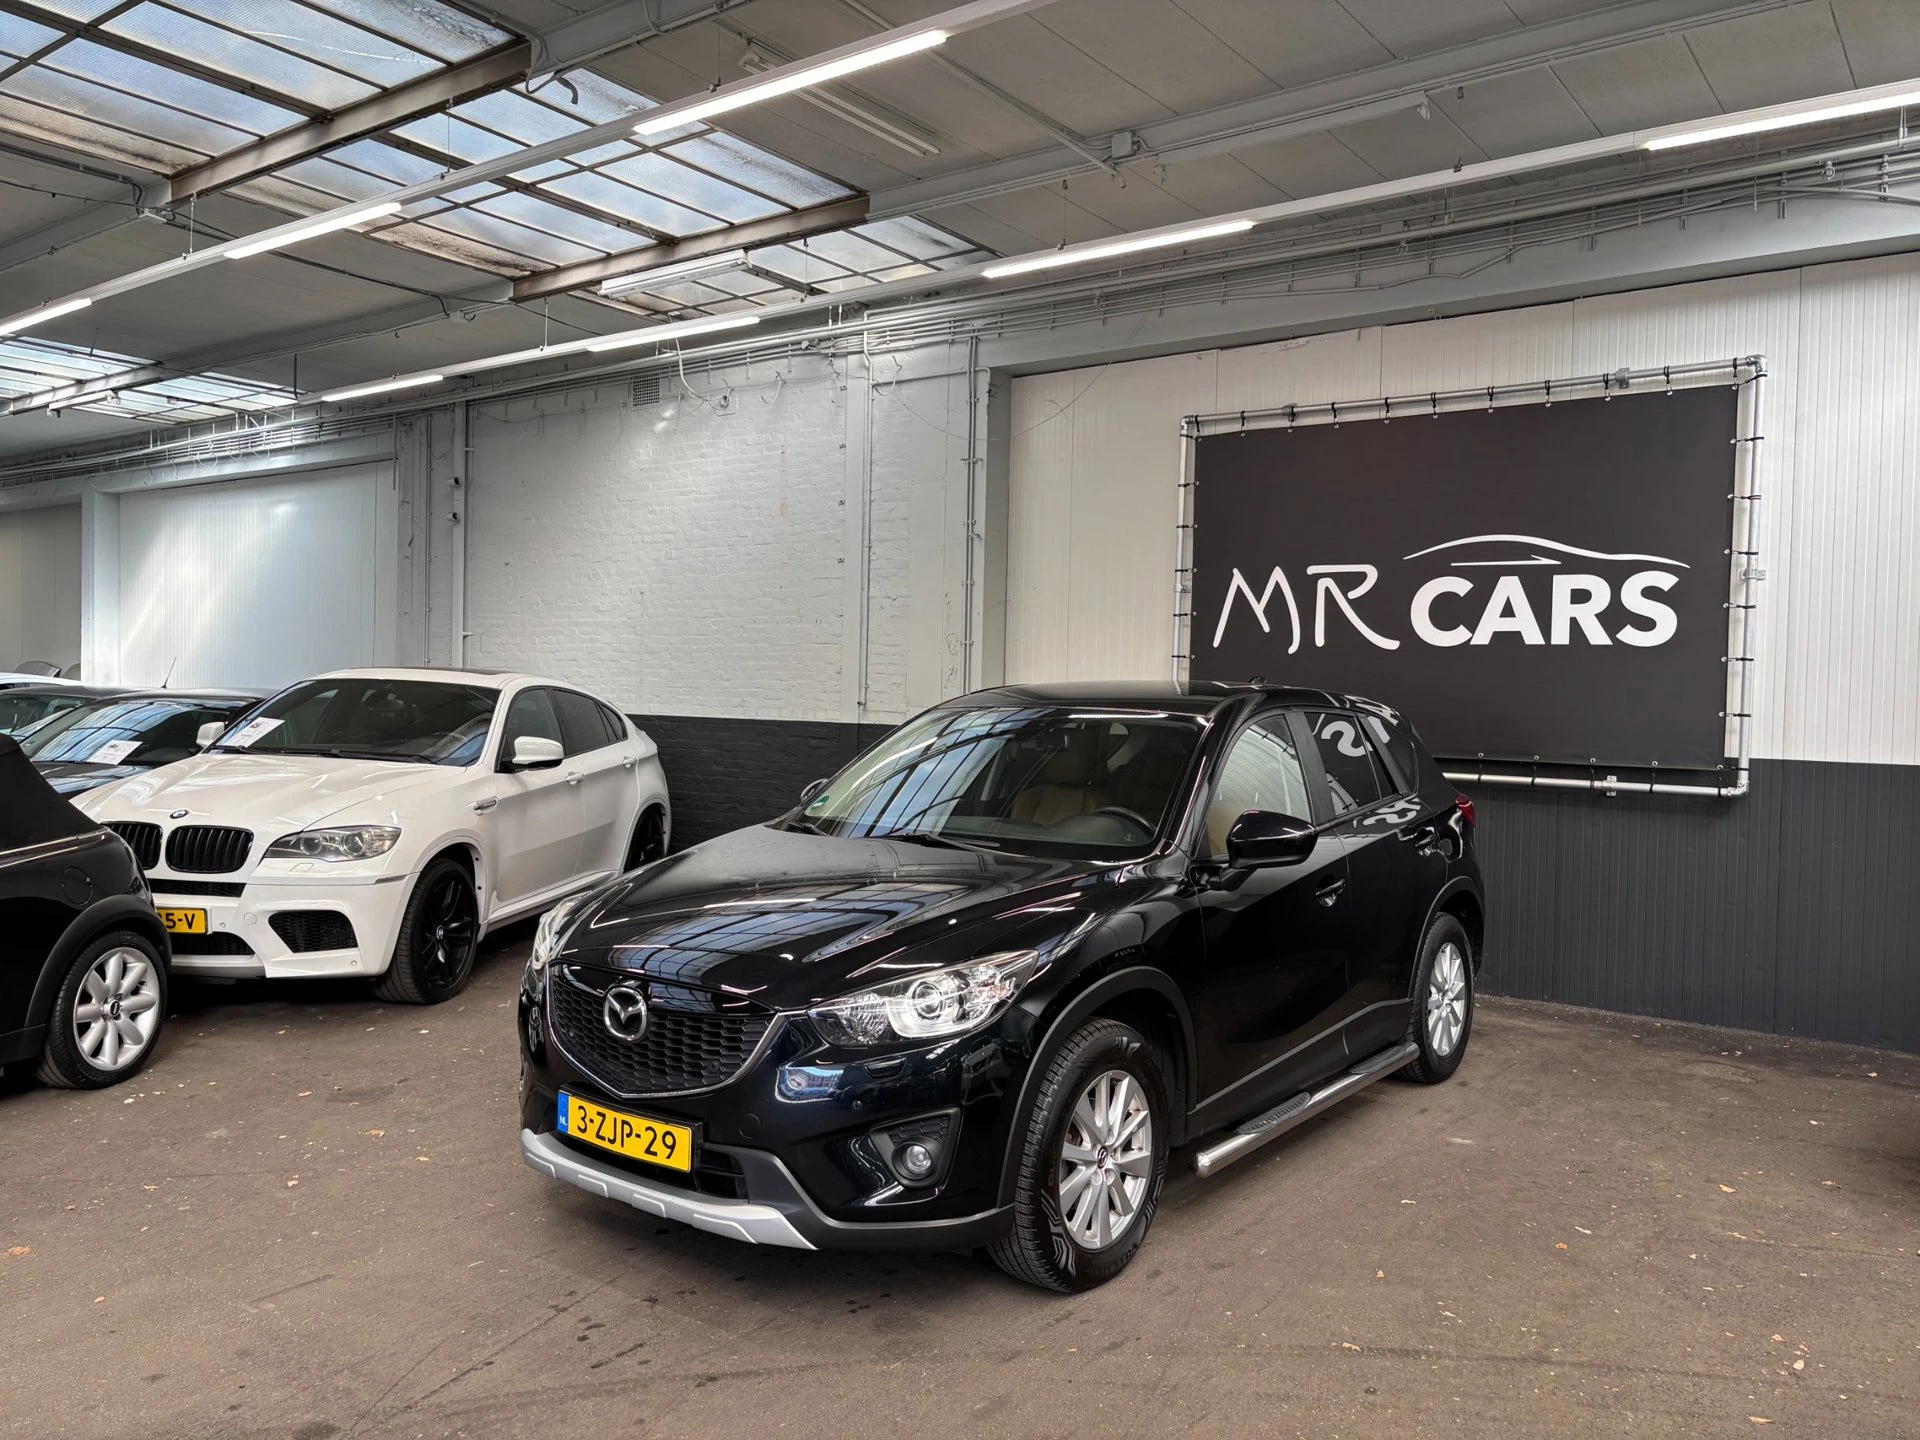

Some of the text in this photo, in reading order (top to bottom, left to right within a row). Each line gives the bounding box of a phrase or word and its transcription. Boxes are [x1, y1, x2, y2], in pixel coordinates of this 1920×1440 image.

[1213, 564, 1680, 655] MR CARS
[157, 912, 196, 931] 5-V
[559, 1114, 568, 1126] NL
[577, 1105, 677, 1160] 3-ZJP-29
